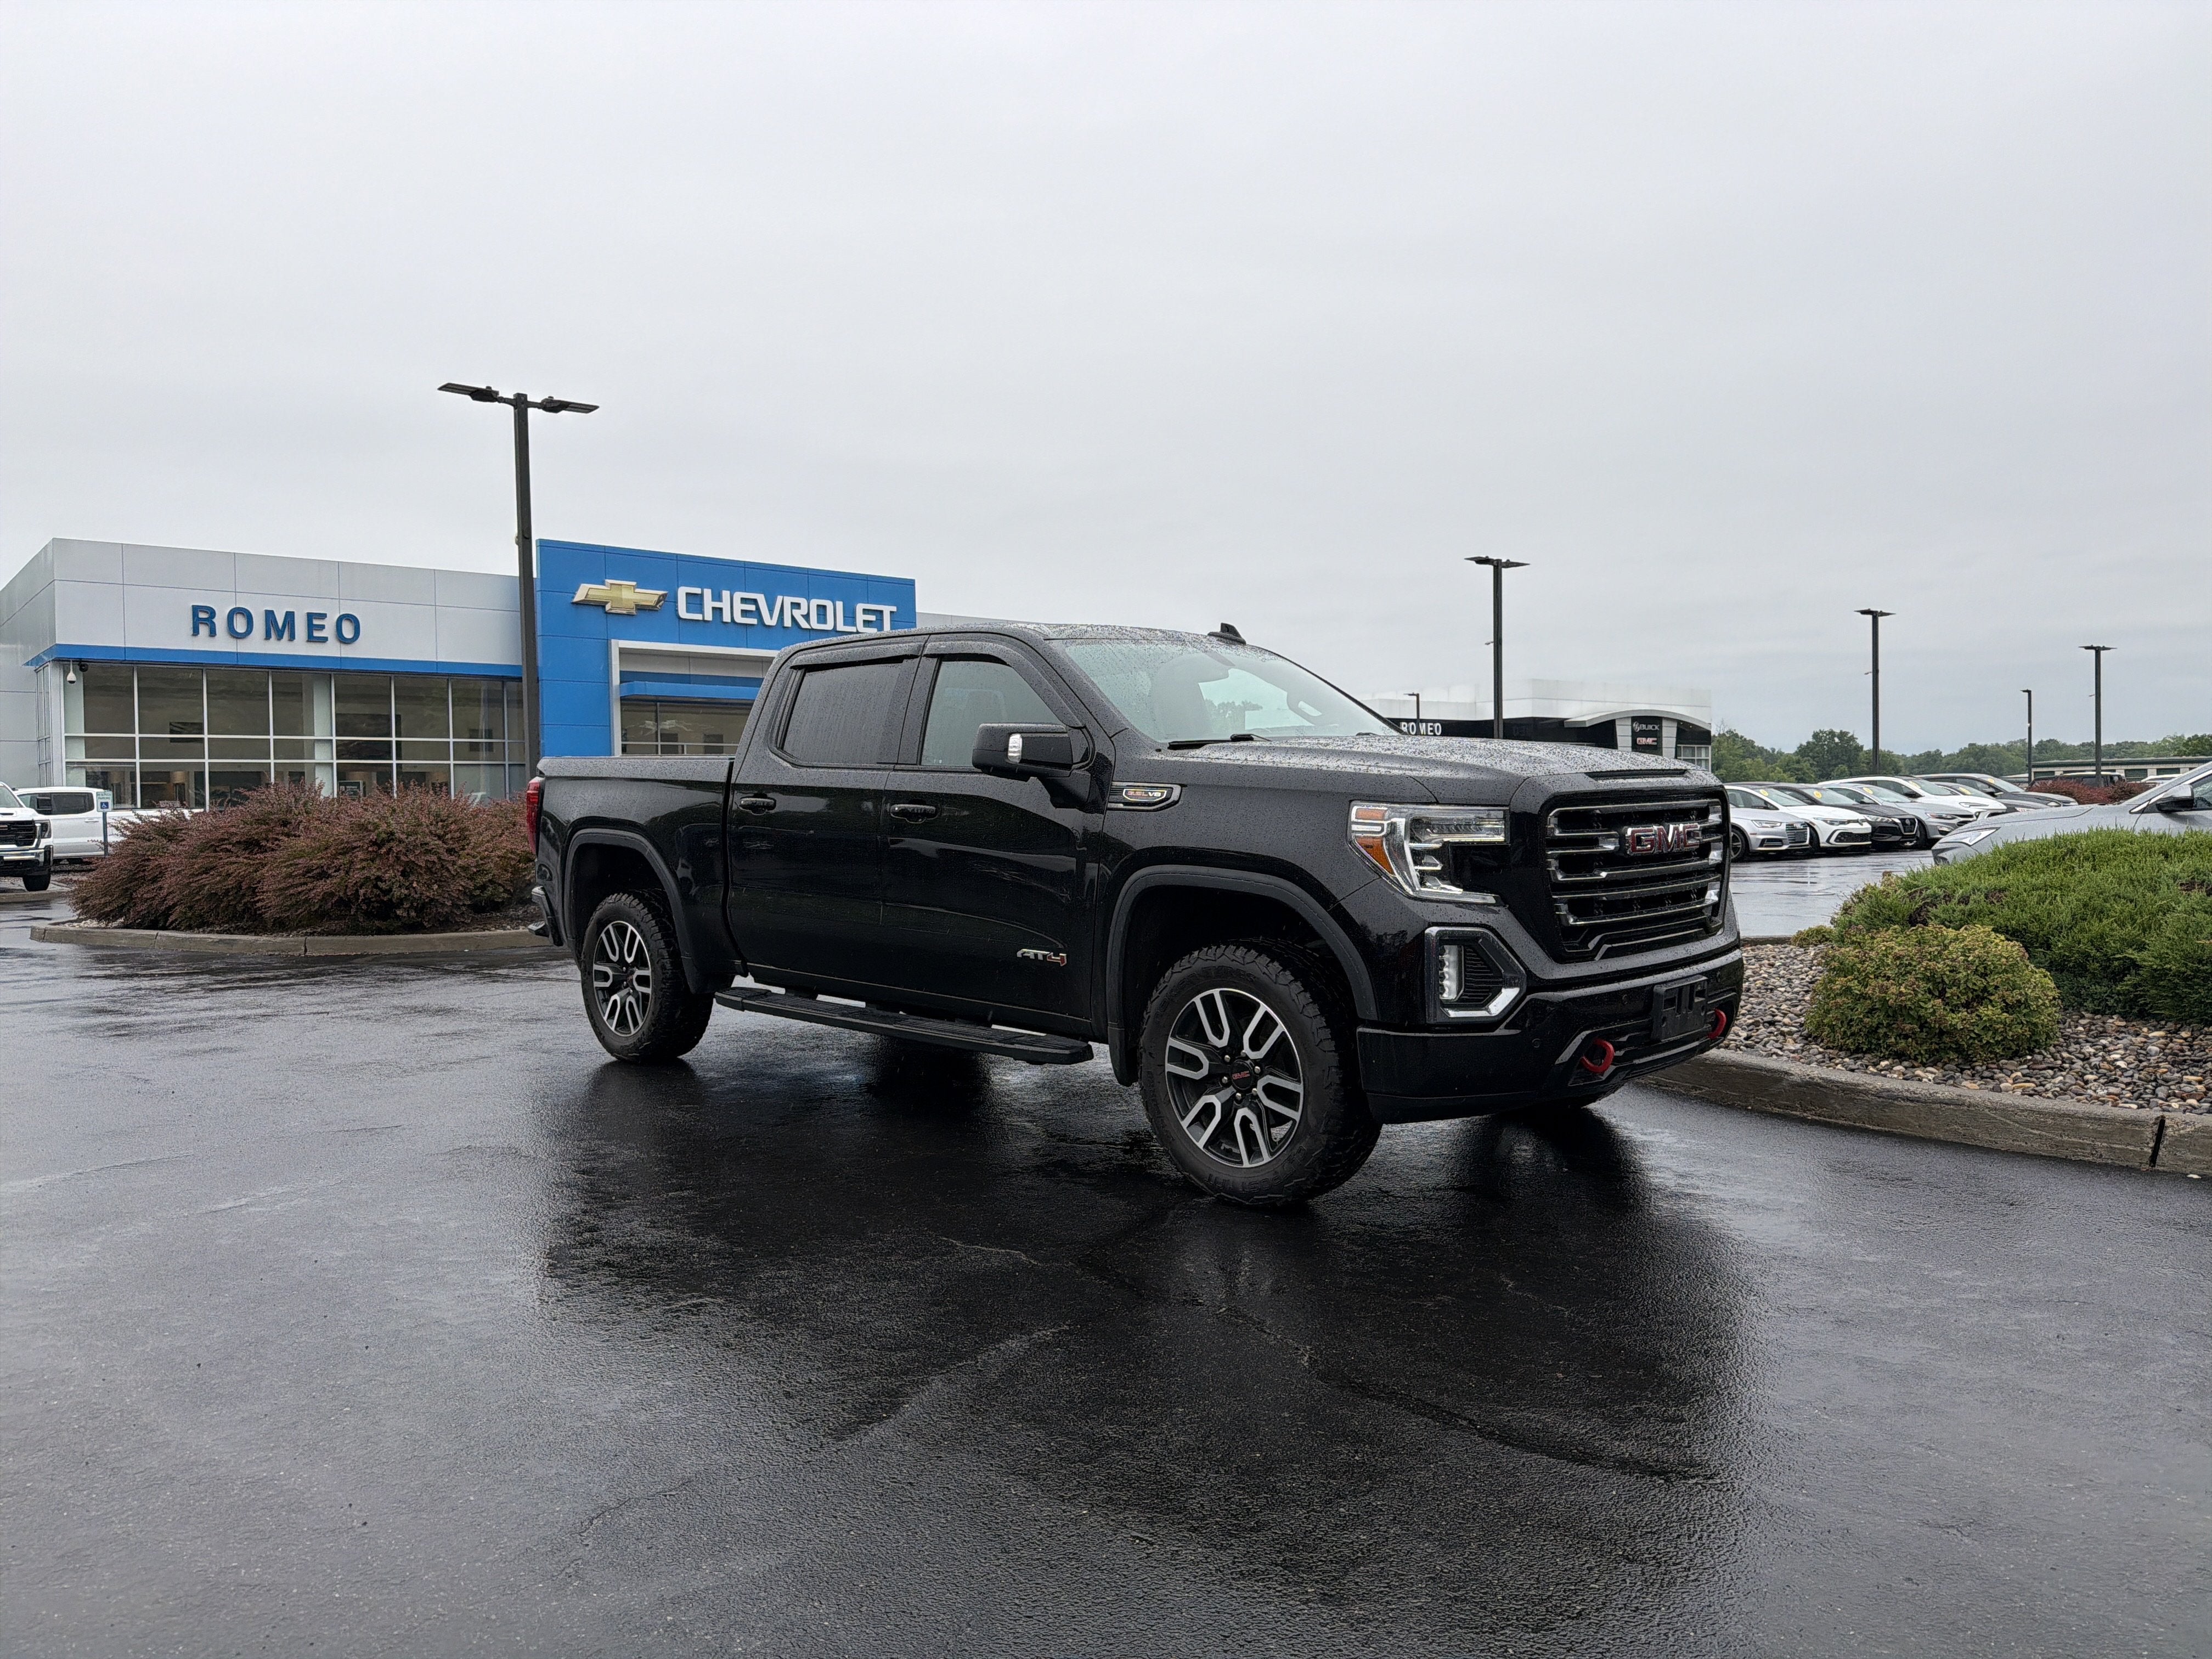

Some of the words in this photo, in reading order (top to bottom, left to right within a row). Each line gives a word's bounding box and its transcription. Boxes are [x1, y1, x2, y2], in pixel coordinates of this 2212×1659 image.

[191, 604, 360, 644] ROMEO
[677, 586, 897, 633] CHEVROLET
[1400, 721, 1442, 736] ROMEO
[1627, 823, 1701, 855] GMC
[1017, 949, 1067, 967] AT4
